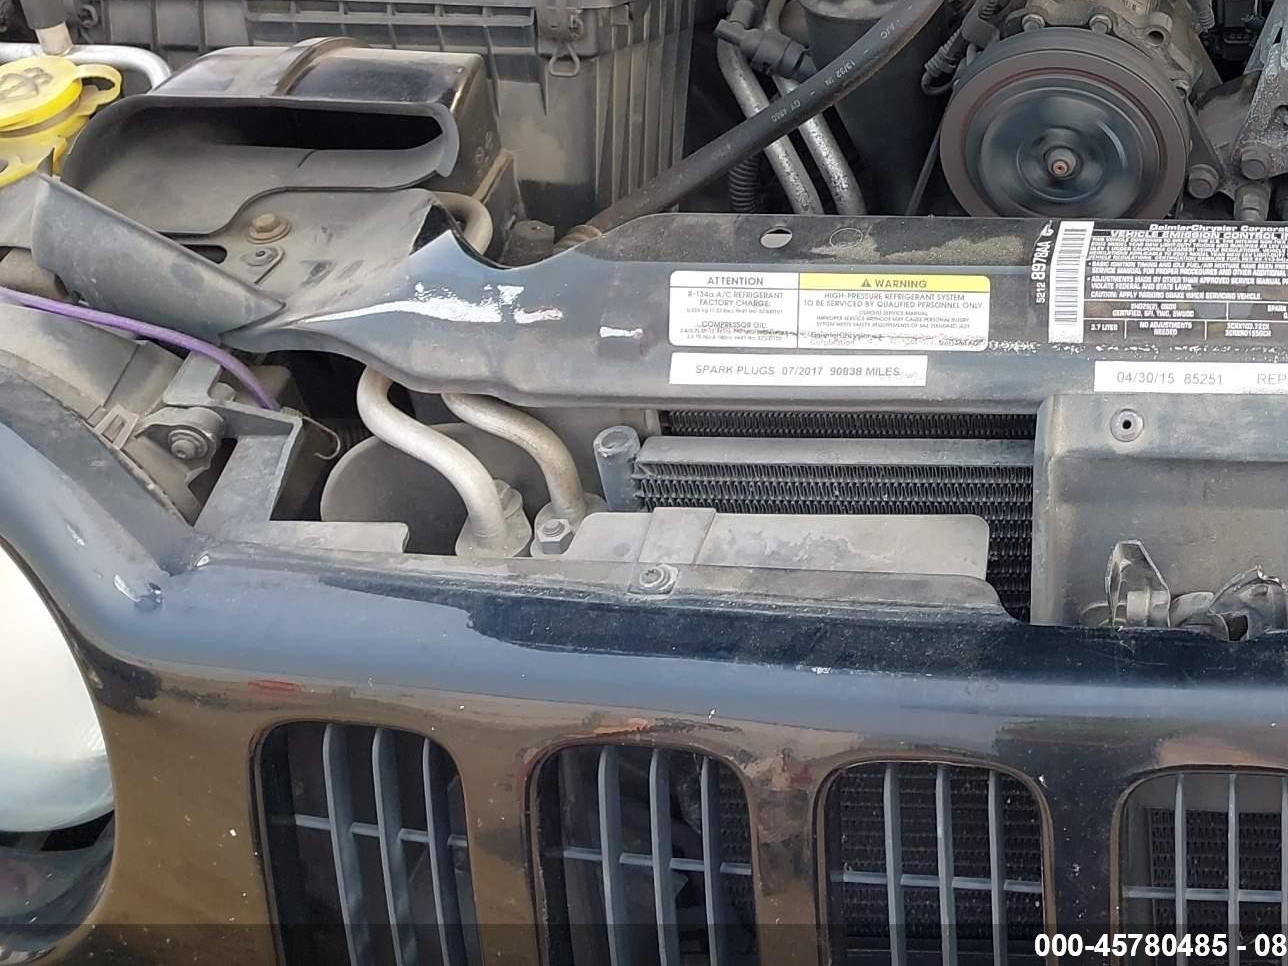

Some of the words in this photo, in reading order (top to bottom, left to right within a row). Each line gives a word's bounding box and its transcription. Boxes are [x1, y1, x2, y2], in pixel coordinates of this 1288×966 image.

[1150, 223, 1237, 233] DaimlerChrysler
[1223, 232, 1277, 240] CONTROL
[1031, 241, 1051, 281] 8978AA
[707, 276, 764, 286] ATTENTION
[874, 279, 927, 289] WARNING
[687, 290, 714, 298] R-134a
[824, 292, 882, 300] HIGH-PRESSURE
[885, 293, 936, 301] REFRIGERANT
[1036, 282, 1046, 304] 5212
[699, 299, 734, 307] FACTORY
[804, 299, 814, 307] TO
[917, 301, 960, 309] PERSONNEL
[701, 320, 752, 328] COMPRESSOR
[695, 364, 734, 375] SPARK
[736, 365, 775, 376] PLUGS
[781, 366, 823, 377] 07/2017
[829, 366, 863, 377] 90838
[865, 367, 901, 377] MILES
[1116, 371, 1176, 385] 04/30/15
[1183, 372, 1223, 386] 85251
